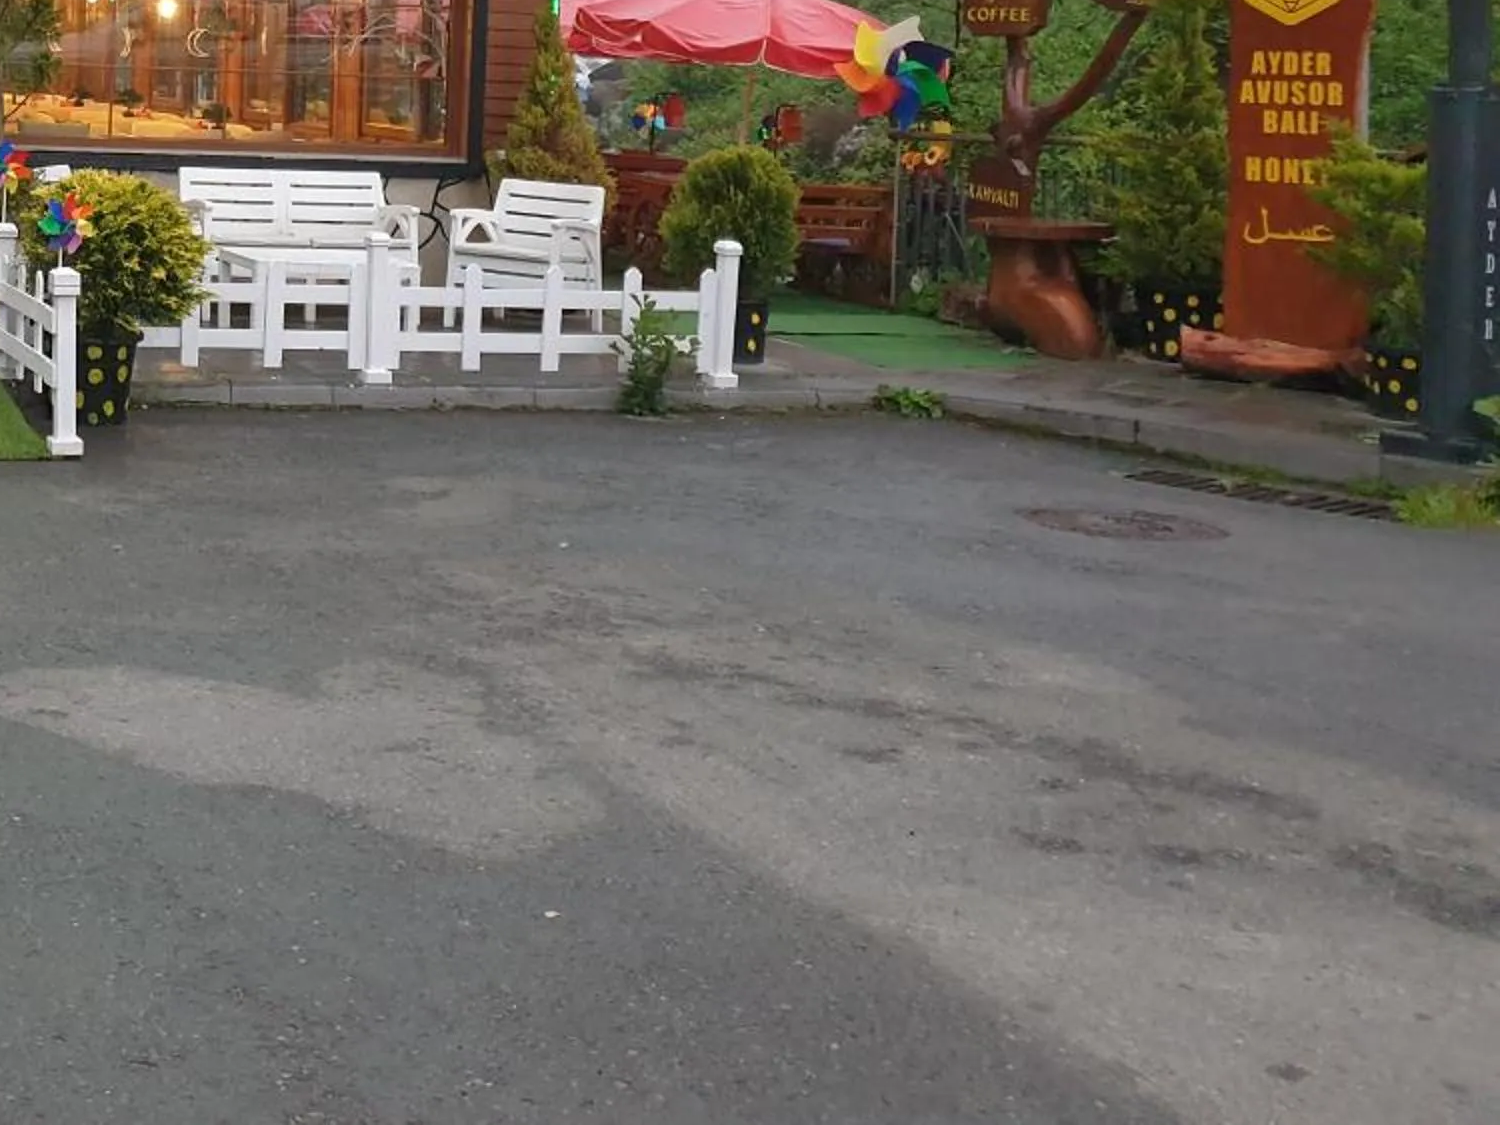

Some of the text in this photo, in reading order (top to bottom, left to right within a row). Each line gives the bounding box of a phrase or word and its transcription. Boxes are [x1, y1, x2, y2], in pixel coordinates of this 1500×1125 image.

[967, 6, 1030, 23] COFFEE
[1251, 50, 1332, 76] AYDER
[1240, 80, 1344, 106] AVUSOR
[1263, 109, 1319, 134] BALI
[1242, 206, 1336, 244] عسل
[1484, 186, 1497, 340] AYDER
